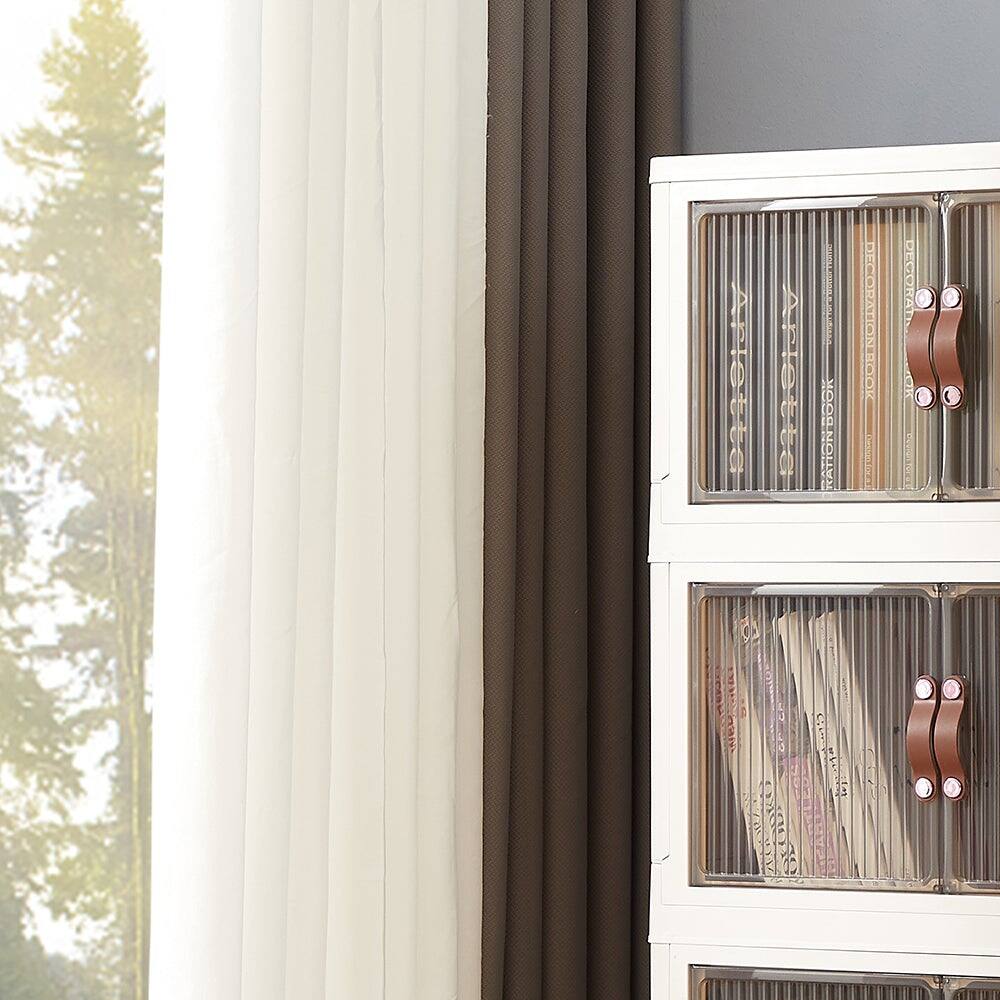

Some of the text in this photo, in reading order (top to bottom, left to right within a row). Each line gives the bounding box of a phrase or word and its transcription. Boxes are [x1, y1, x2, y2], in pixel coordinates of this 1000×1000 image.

[864, 241, 875, 401] DECORATION BOOK
[904, 239, 914, 333] DECORATI
[821, 378, 834, 426] BOOK
